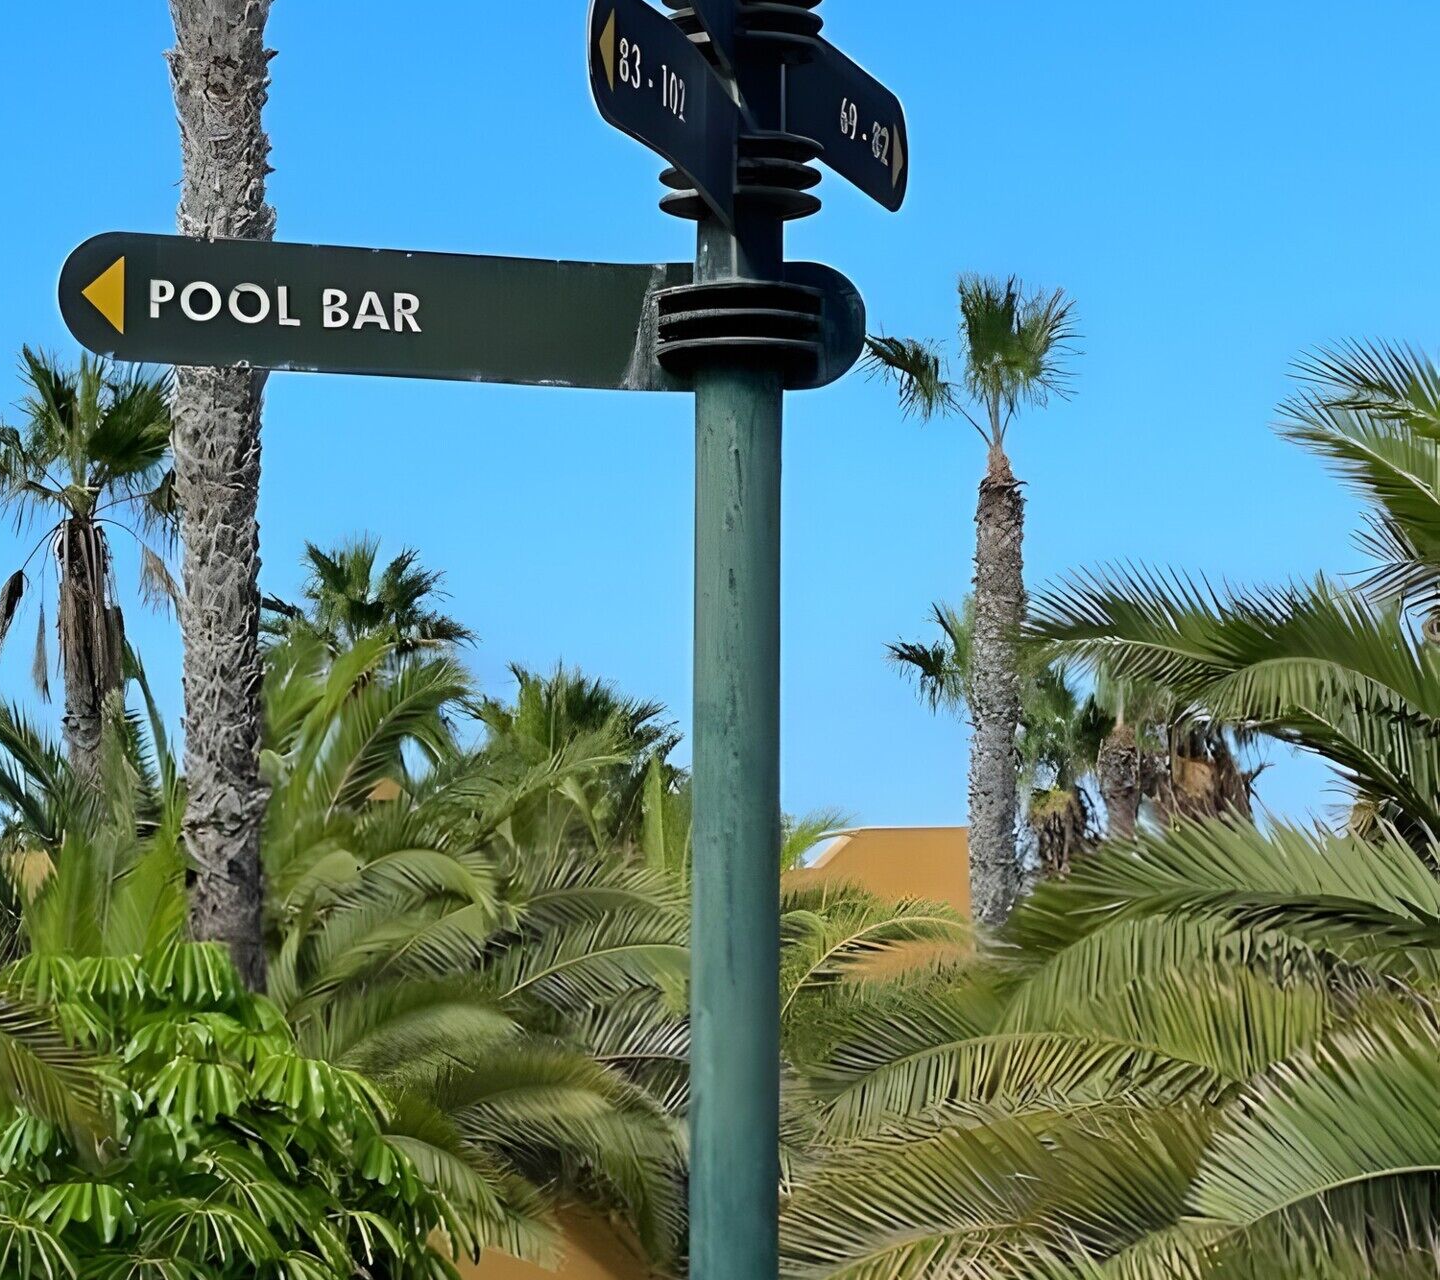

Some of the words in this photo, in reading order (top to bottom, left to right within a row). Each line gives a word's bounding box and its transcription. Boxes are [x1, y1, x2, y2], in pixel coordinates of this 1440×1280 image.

[619, 37, 641, 90] 83
[840, 97, 858, 140] 69
[149, 278, 301, 327] POOL
[322, 287, 423, 333] BAR
